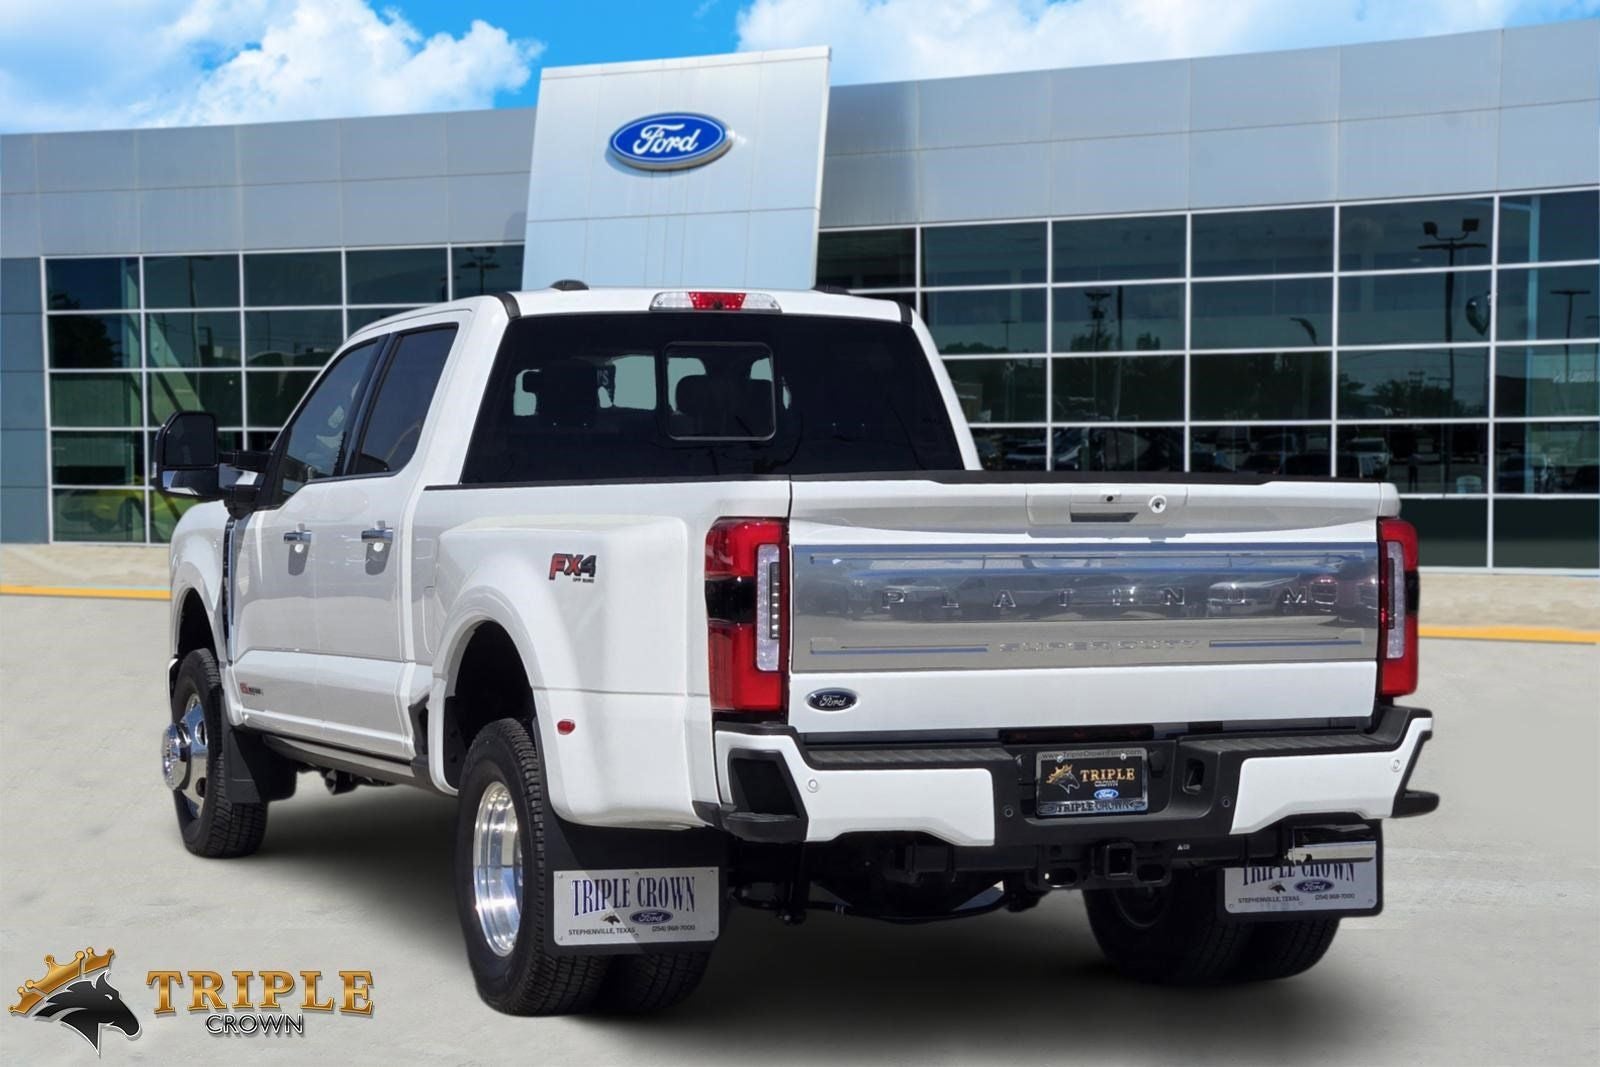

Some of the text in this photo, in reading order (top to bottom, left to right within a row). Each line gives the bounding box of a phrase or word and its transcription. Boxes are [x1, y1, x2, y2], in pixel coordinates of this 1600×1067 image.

[632, 123, 701, 155] Ford
[549, 553, 597, 580] FX4
[819, 695, 847, 707] Ford
[1080, 768, 1135, 782] TRIPLE
[1056, 801, 1095, 813] TRIPLE
[1303, 881, 1326, 891] Ford
[572, 876, 695, 916] TRIPLE CROWN
[638, 911, 664, 923] Ford
[568, 926, 636, 936] STEPHENVILLE, TEXAS
